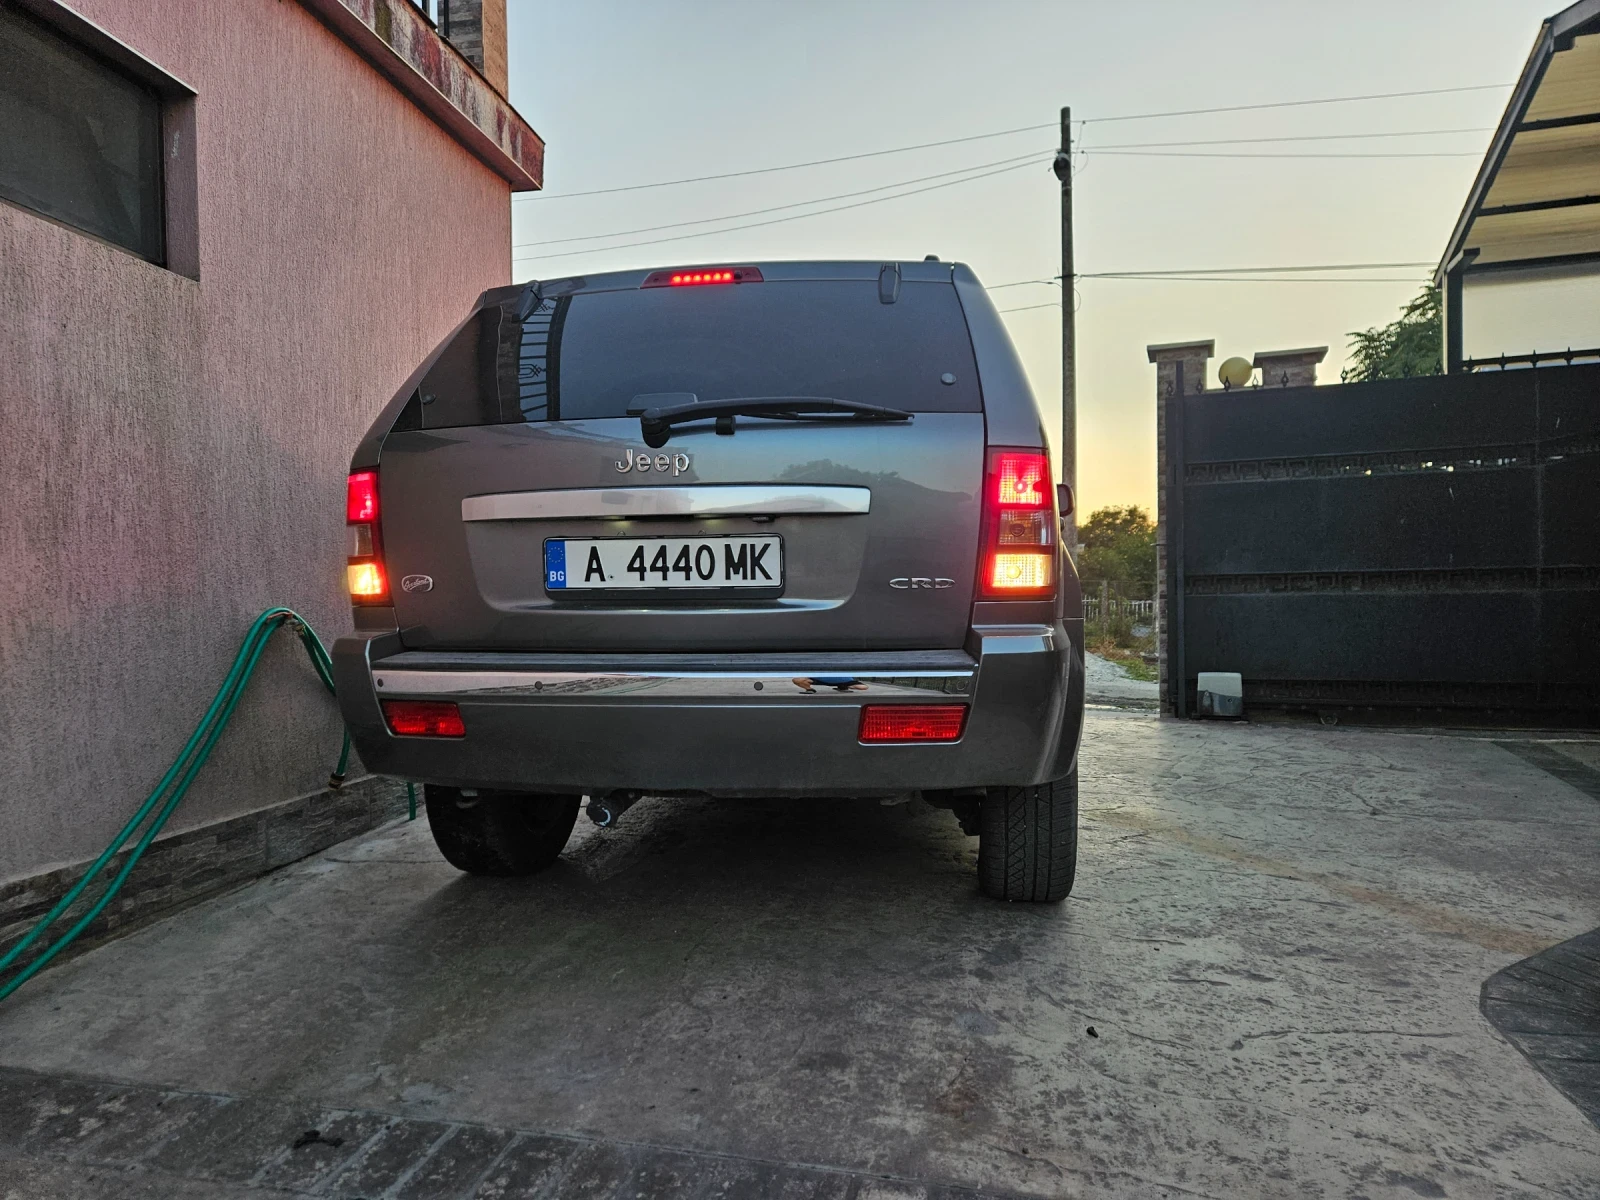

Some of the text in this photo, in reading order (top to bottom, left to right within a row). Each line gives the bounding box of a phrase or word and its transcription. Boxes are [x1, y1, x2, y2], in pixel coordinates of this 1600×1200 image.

[614, 449, 690, 477] Jeep
[584, 543, 773, 582] A 4440 MK
[549, 570, 565, 582] BG
[889, 577, 956, 589] CRD
